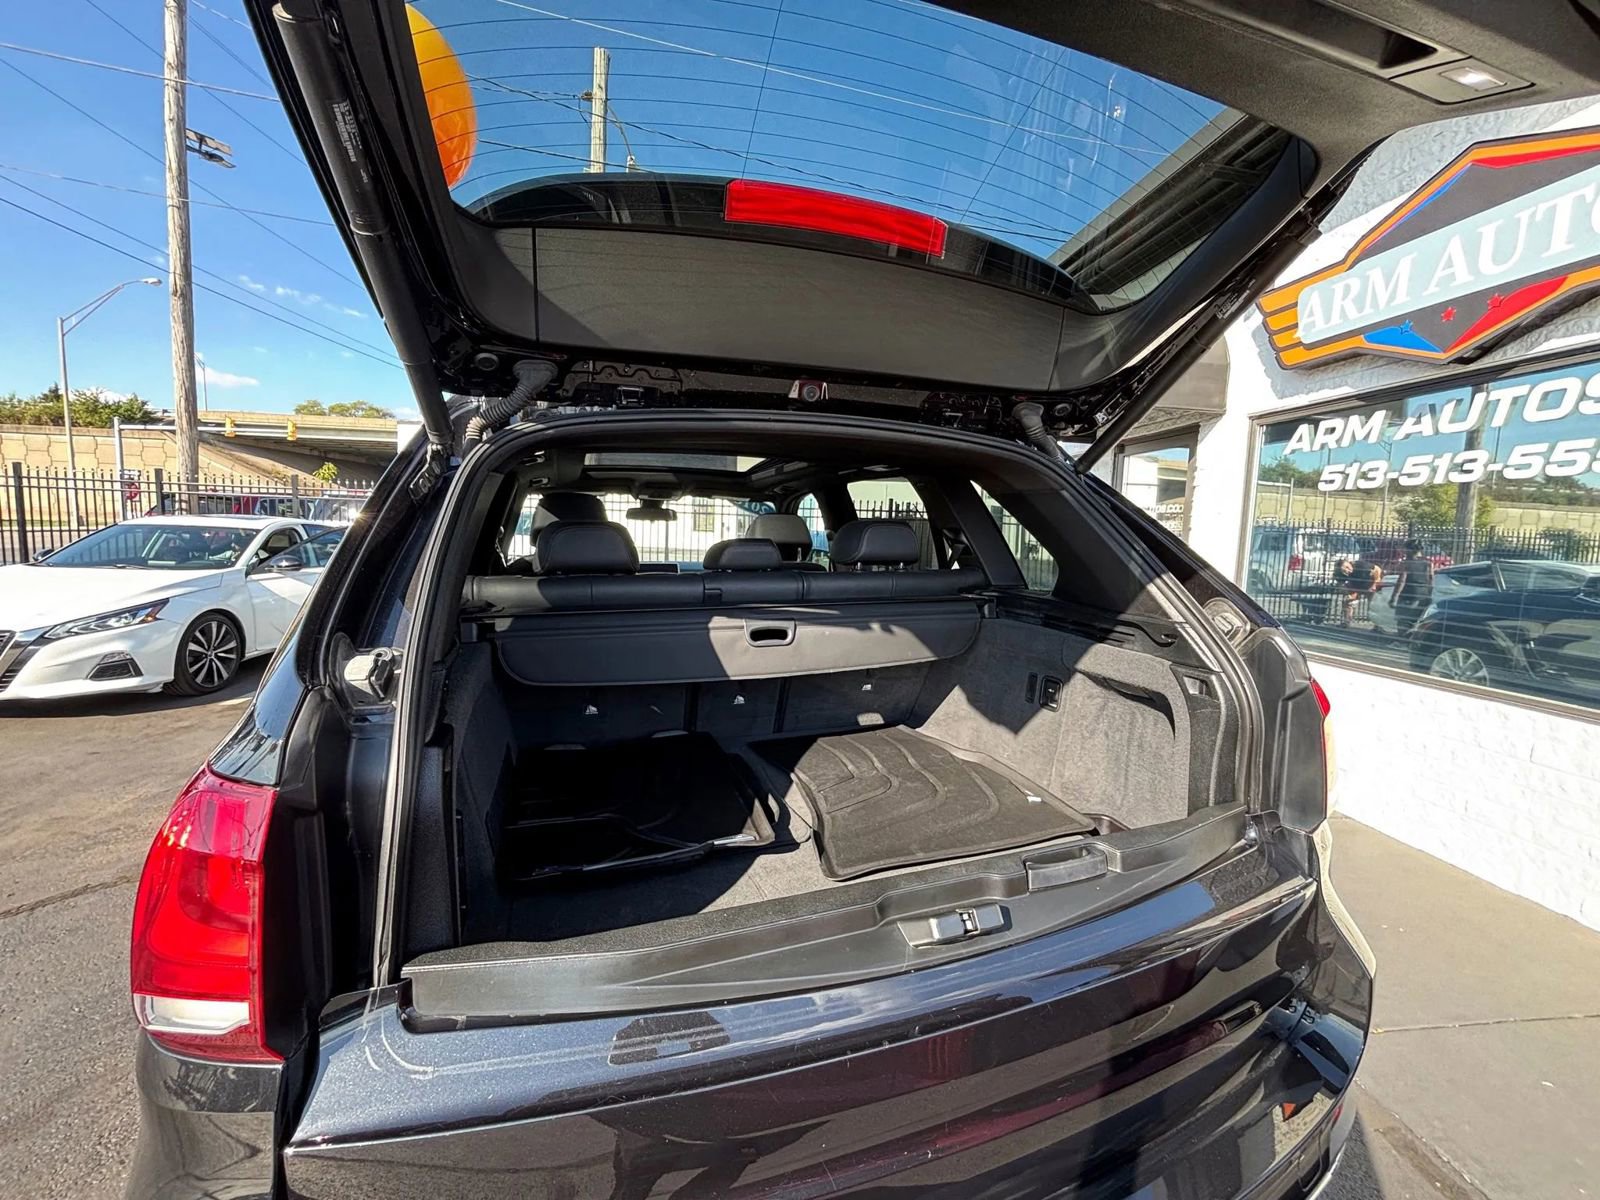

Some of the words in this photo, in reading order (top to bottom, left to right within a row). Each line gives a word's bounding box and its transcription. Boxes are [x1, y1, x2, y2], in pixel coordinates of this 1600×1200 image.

[1293, 252, 1418, 338] ARM
[1423, 181, 1600, 295] AUT
[1283, 409, 1387, 456] ARM
[1318, 438, 1600, 491] 513-513-55
